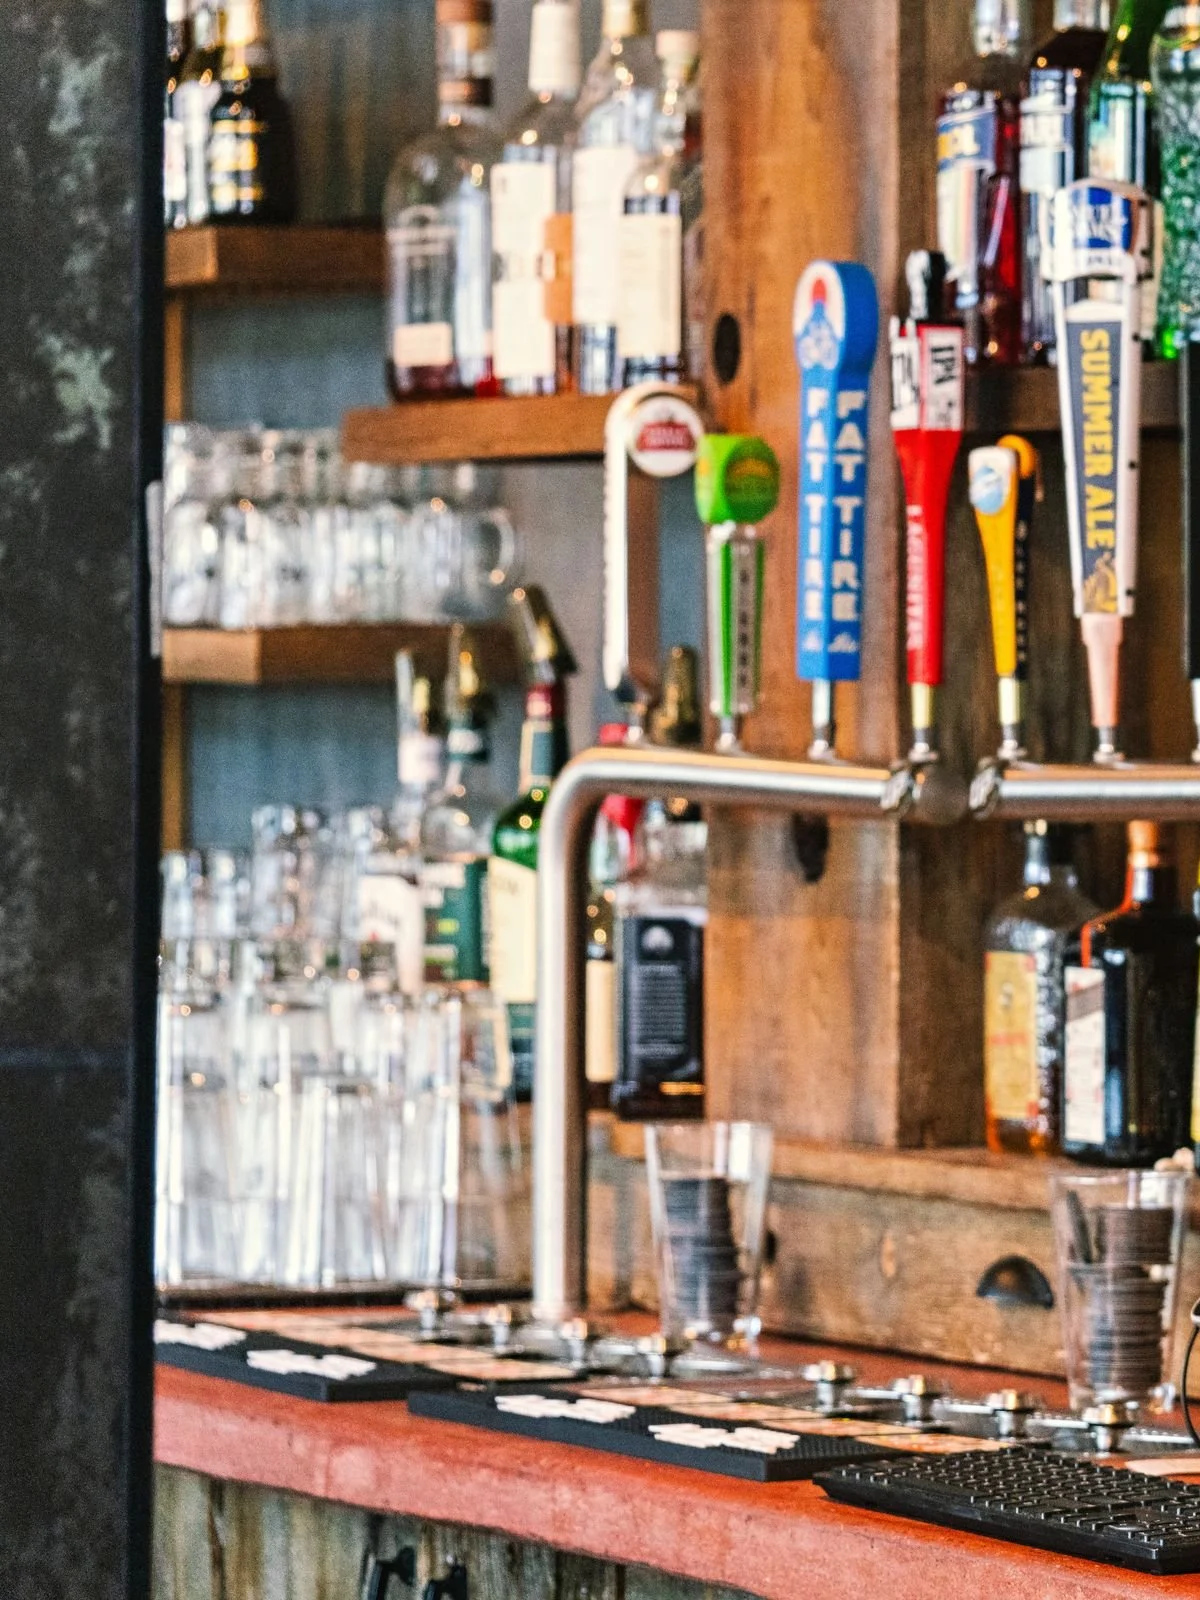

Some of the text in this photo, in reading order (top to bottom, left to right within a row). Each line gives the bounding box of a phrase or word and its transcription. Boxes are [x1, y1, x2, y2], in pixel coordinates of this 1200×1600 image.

[834, 390, 866, 483] FAT
[1080, 327, 1116, 551] SUMMER ALE
[831, 496, 862, 623] TIRE
